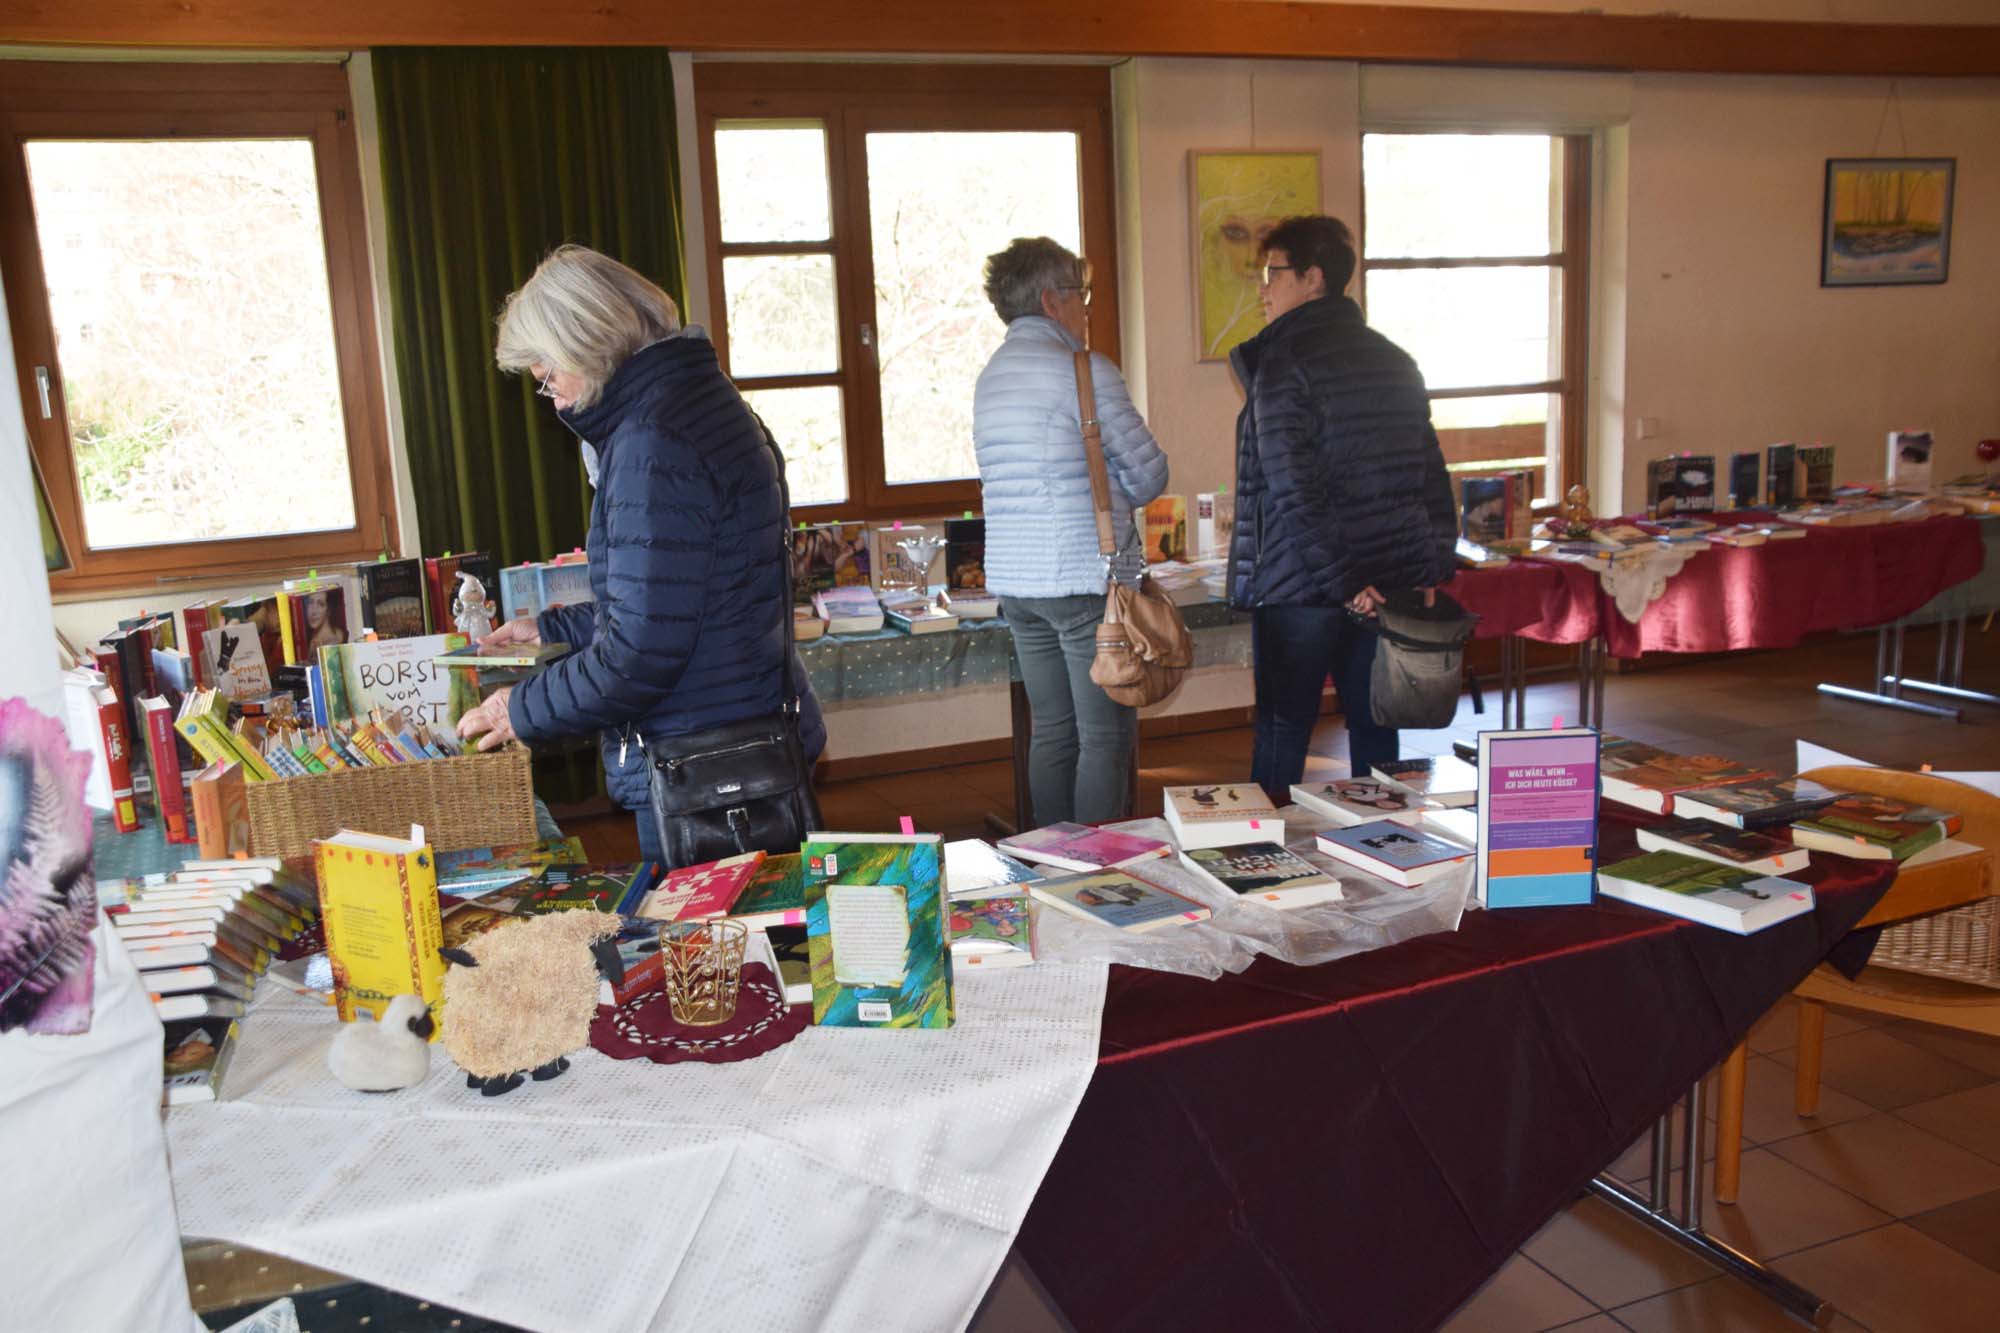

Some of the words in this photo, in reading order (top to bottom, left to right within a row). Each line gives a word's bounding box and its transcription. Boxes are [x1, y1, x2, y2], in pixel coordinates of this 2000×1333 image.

[360, 658, 437, 689] BORST
[1508, 768, 1524, 778] WAS
[1546, 767, 1566, 777] WENN
[1504, 780, 1517, 791] ICH
[1517, 779, 1533, 790] DICH
[1533, 778, 1553, 789] HEUTE
[1553, 776, 1578, 788] KÜSSE?
